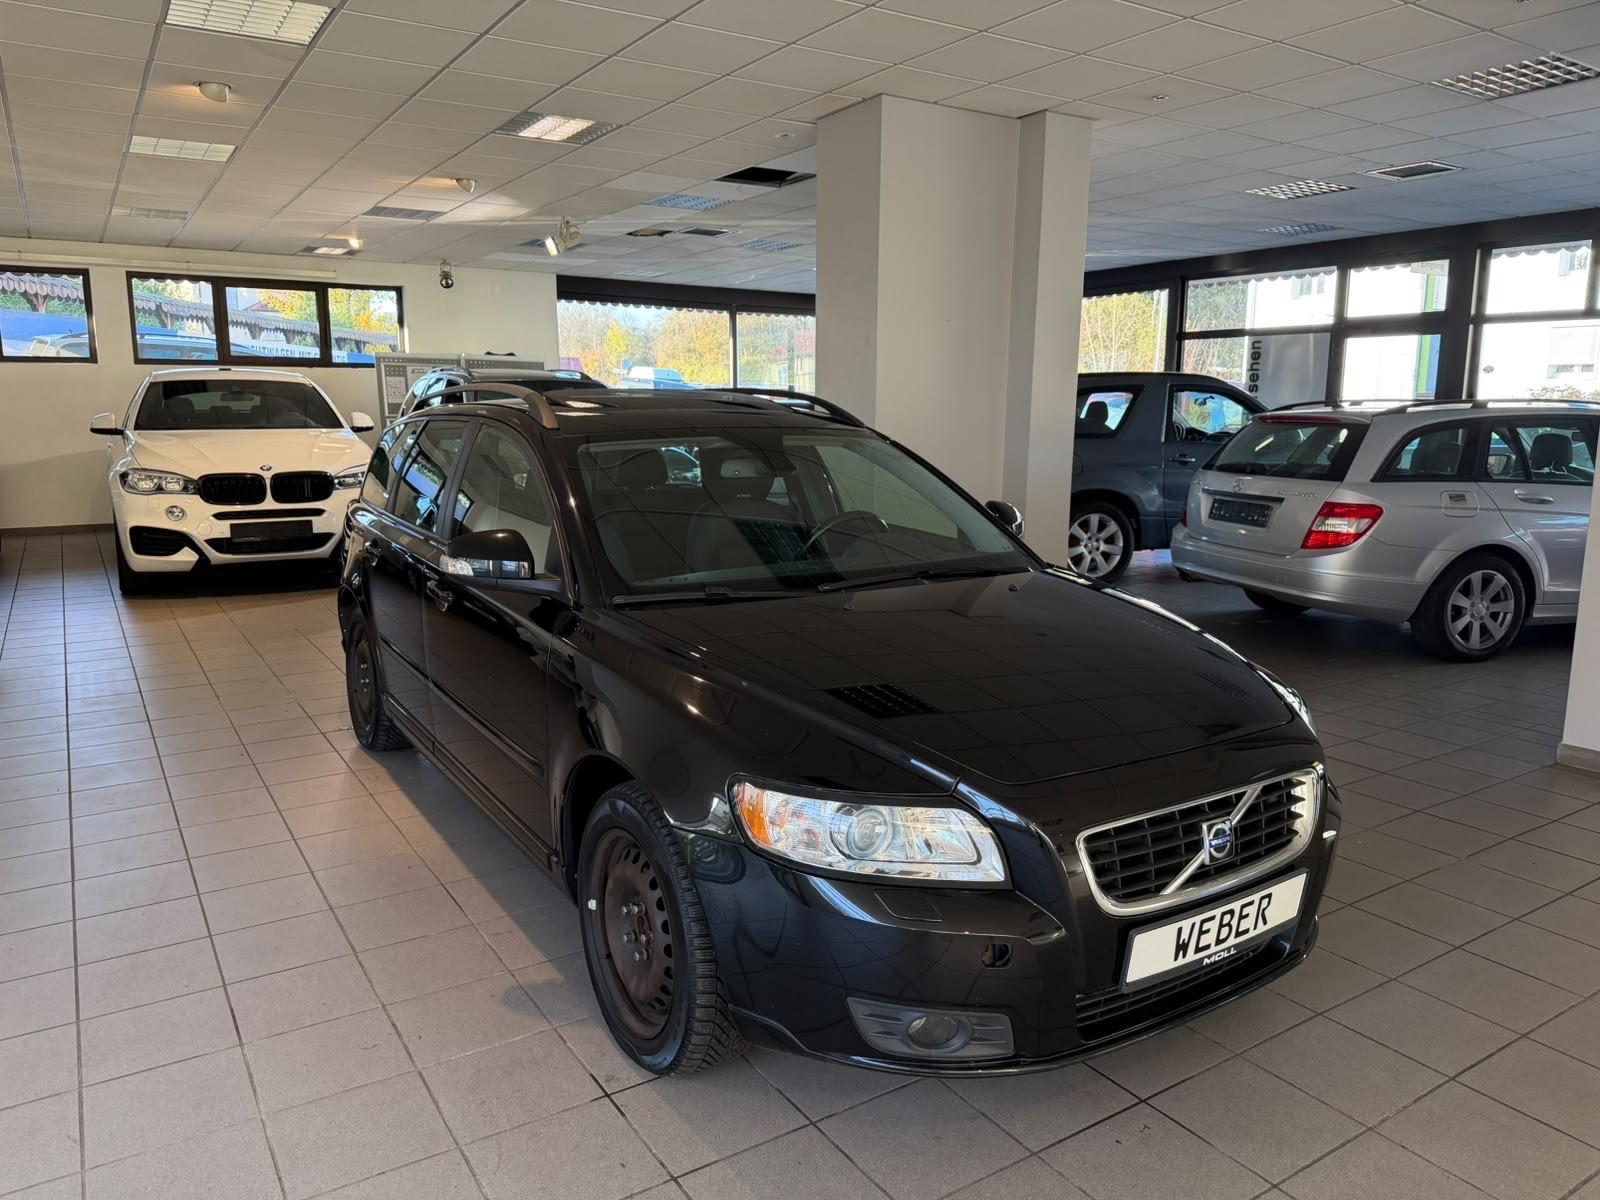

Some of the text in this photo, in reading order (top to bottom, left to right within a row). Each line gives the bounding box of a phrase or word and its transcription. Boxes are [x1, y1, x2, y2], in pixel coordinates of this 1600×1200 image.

[1248, 340, 1262, 399] sehen
[1173, 892, 1273, 962] WEBER
[1203, 947, 1237, 965] MOLL
